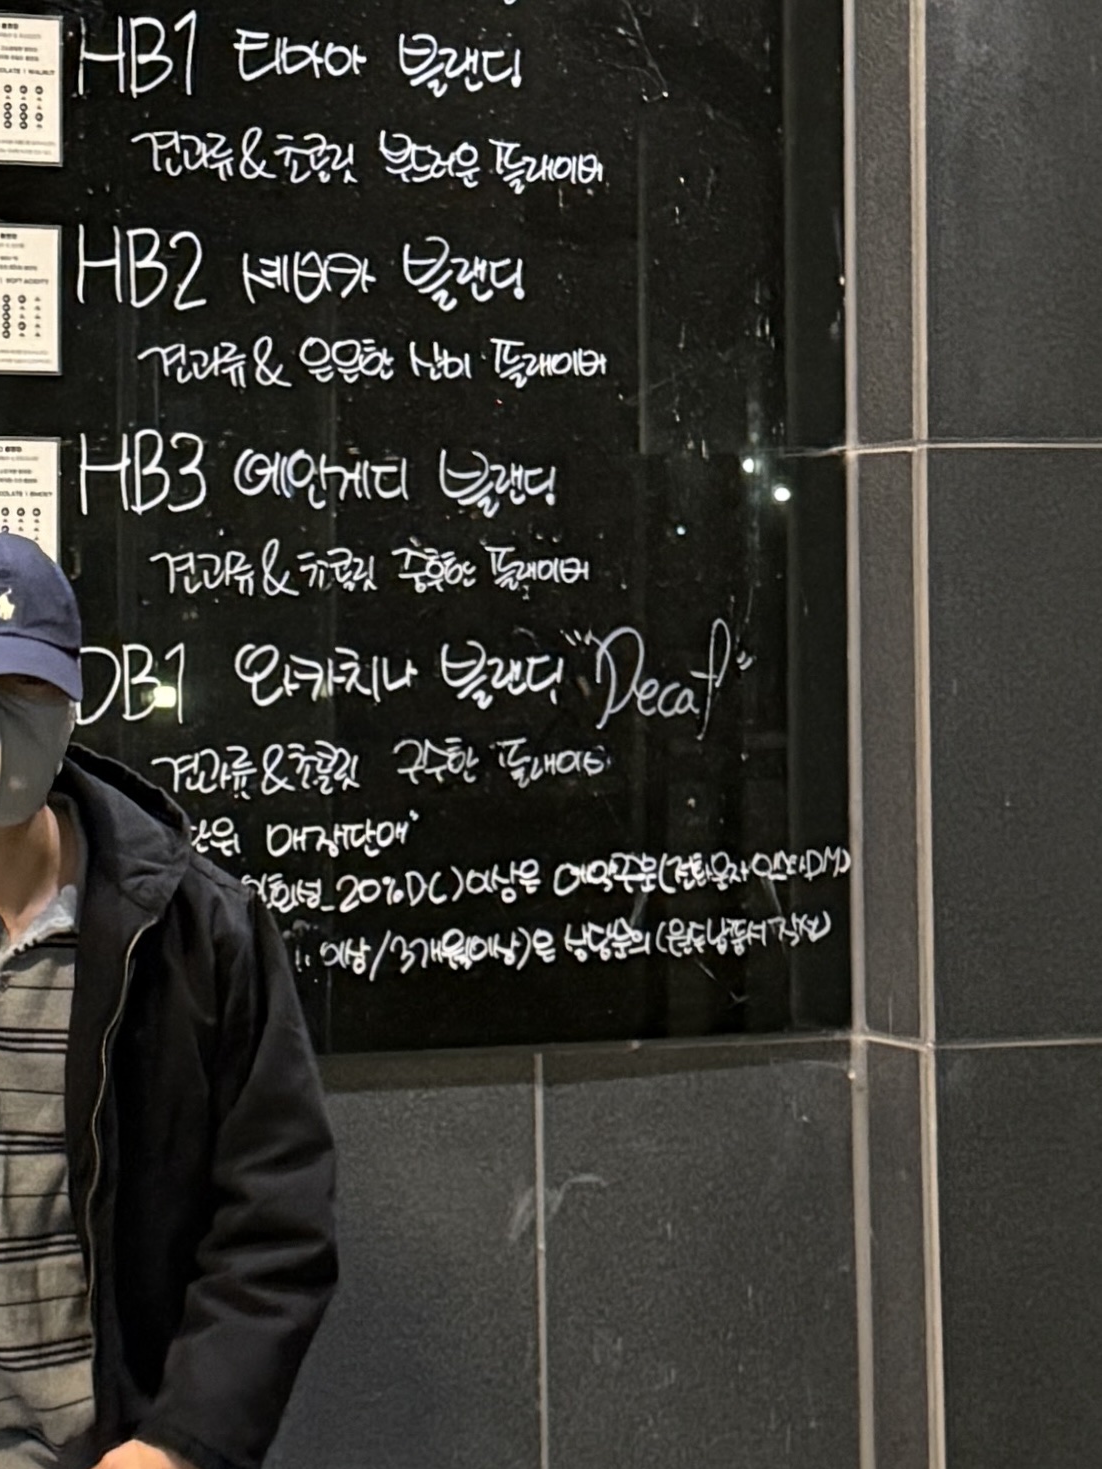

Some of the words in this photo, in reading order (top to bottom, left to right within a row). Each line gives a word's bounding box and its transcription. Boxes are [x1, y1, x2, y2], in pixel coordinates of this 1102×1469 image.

[79, 10, 196, 98] HB1
[77, 225, 206, 310] HB2
[80, 429, 206, 515] HB3
